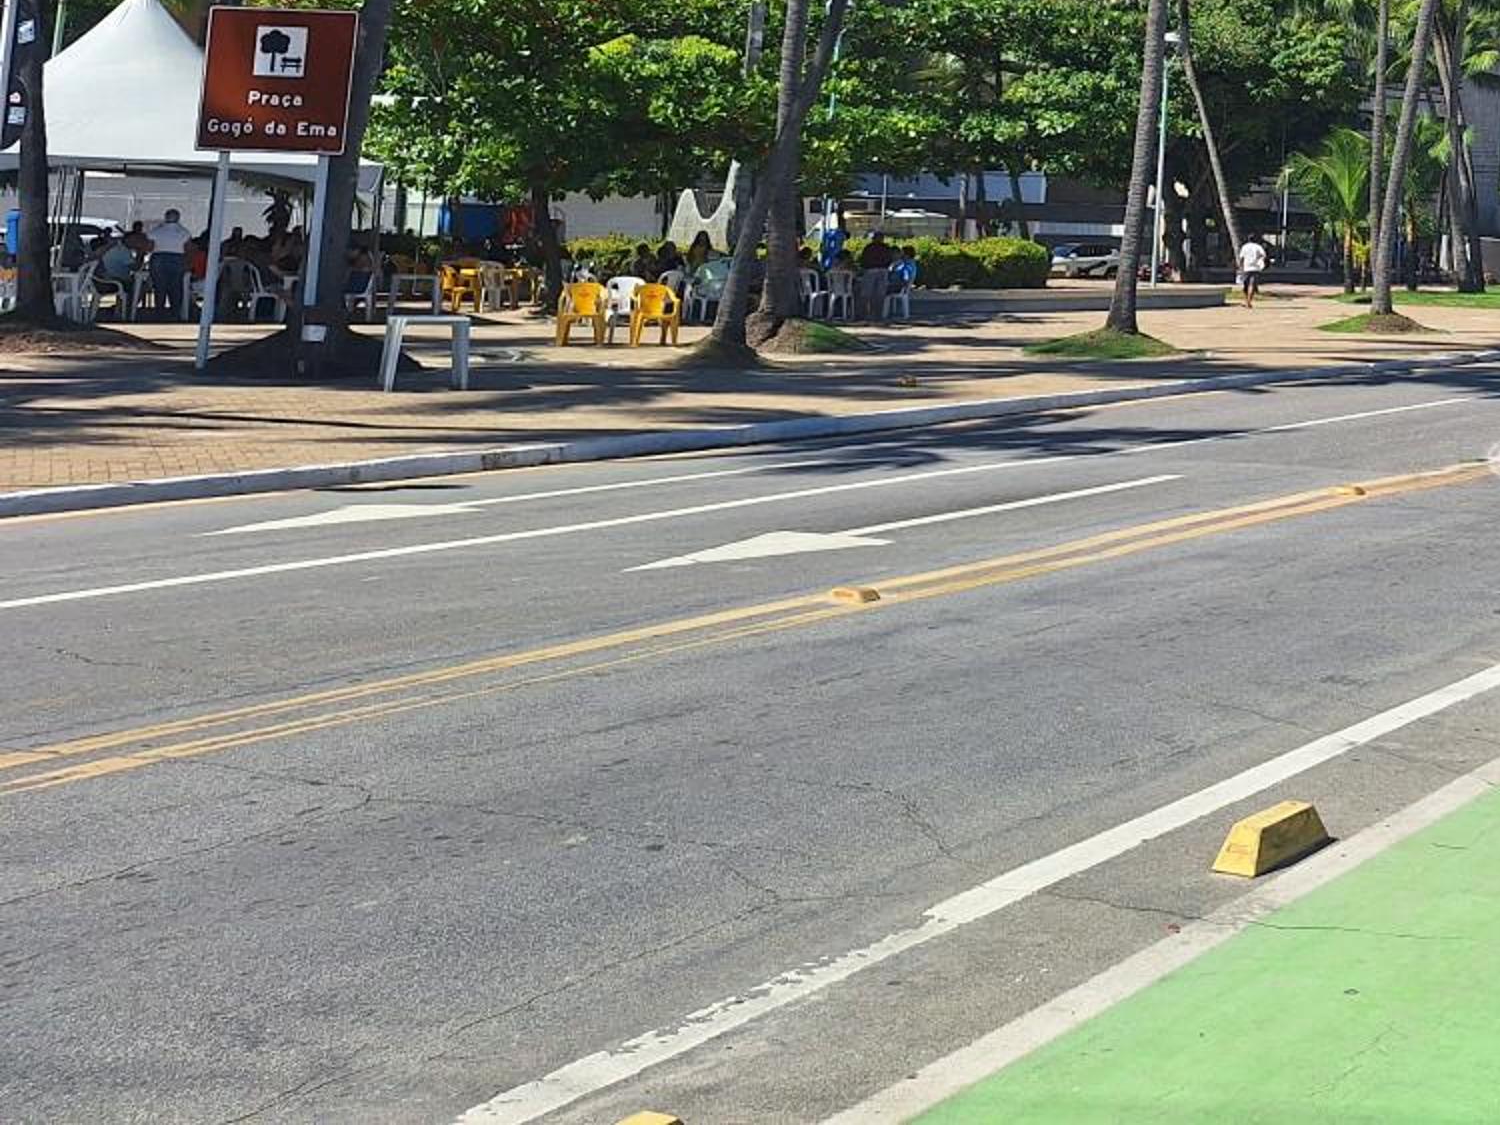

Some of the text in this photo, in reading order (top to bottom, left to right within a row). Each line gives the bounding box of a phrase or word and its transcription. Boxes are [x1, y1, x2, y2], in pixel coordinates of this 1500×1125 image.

[248, 90, 303, 107] Praça
[207, 118, 337, 137] Gogó da Ema
